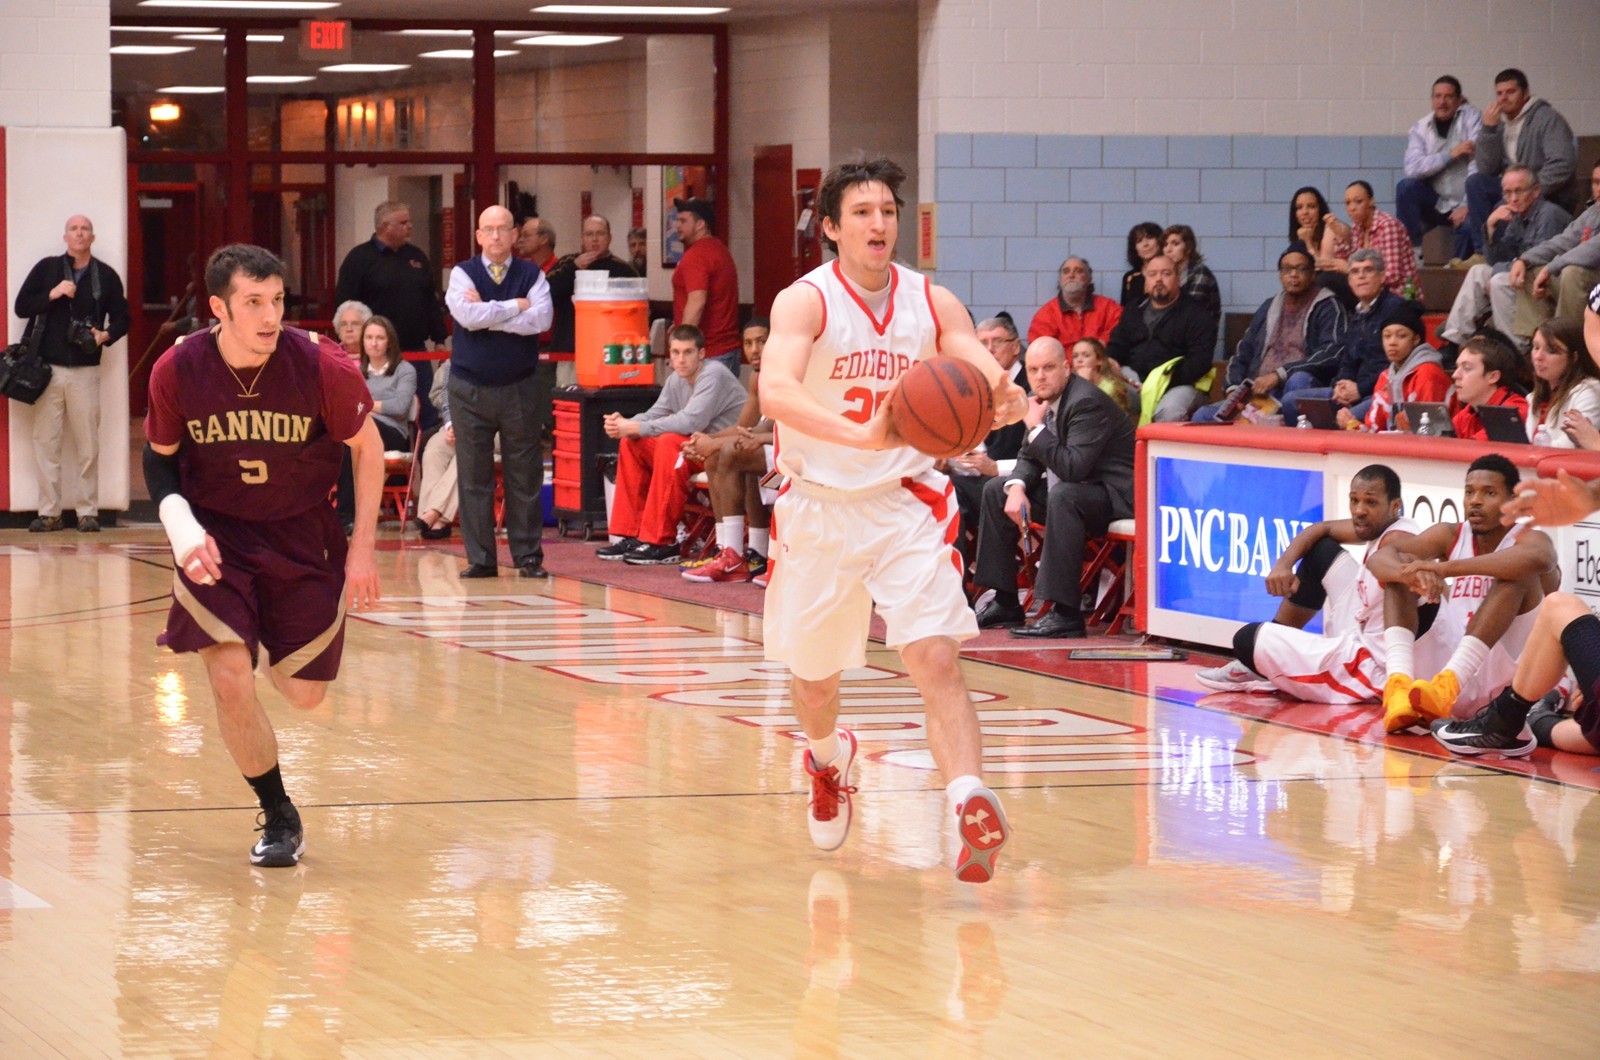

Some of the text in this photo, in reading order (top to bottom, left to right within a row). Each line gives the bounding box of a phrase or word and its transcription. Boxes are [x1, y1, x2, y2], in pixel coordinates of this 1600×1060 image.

[310, 21, 346, 49] EXIT
[187, 409, 312, 445] GANNON
[1158, 505, 1314, 578] PNC BAN
